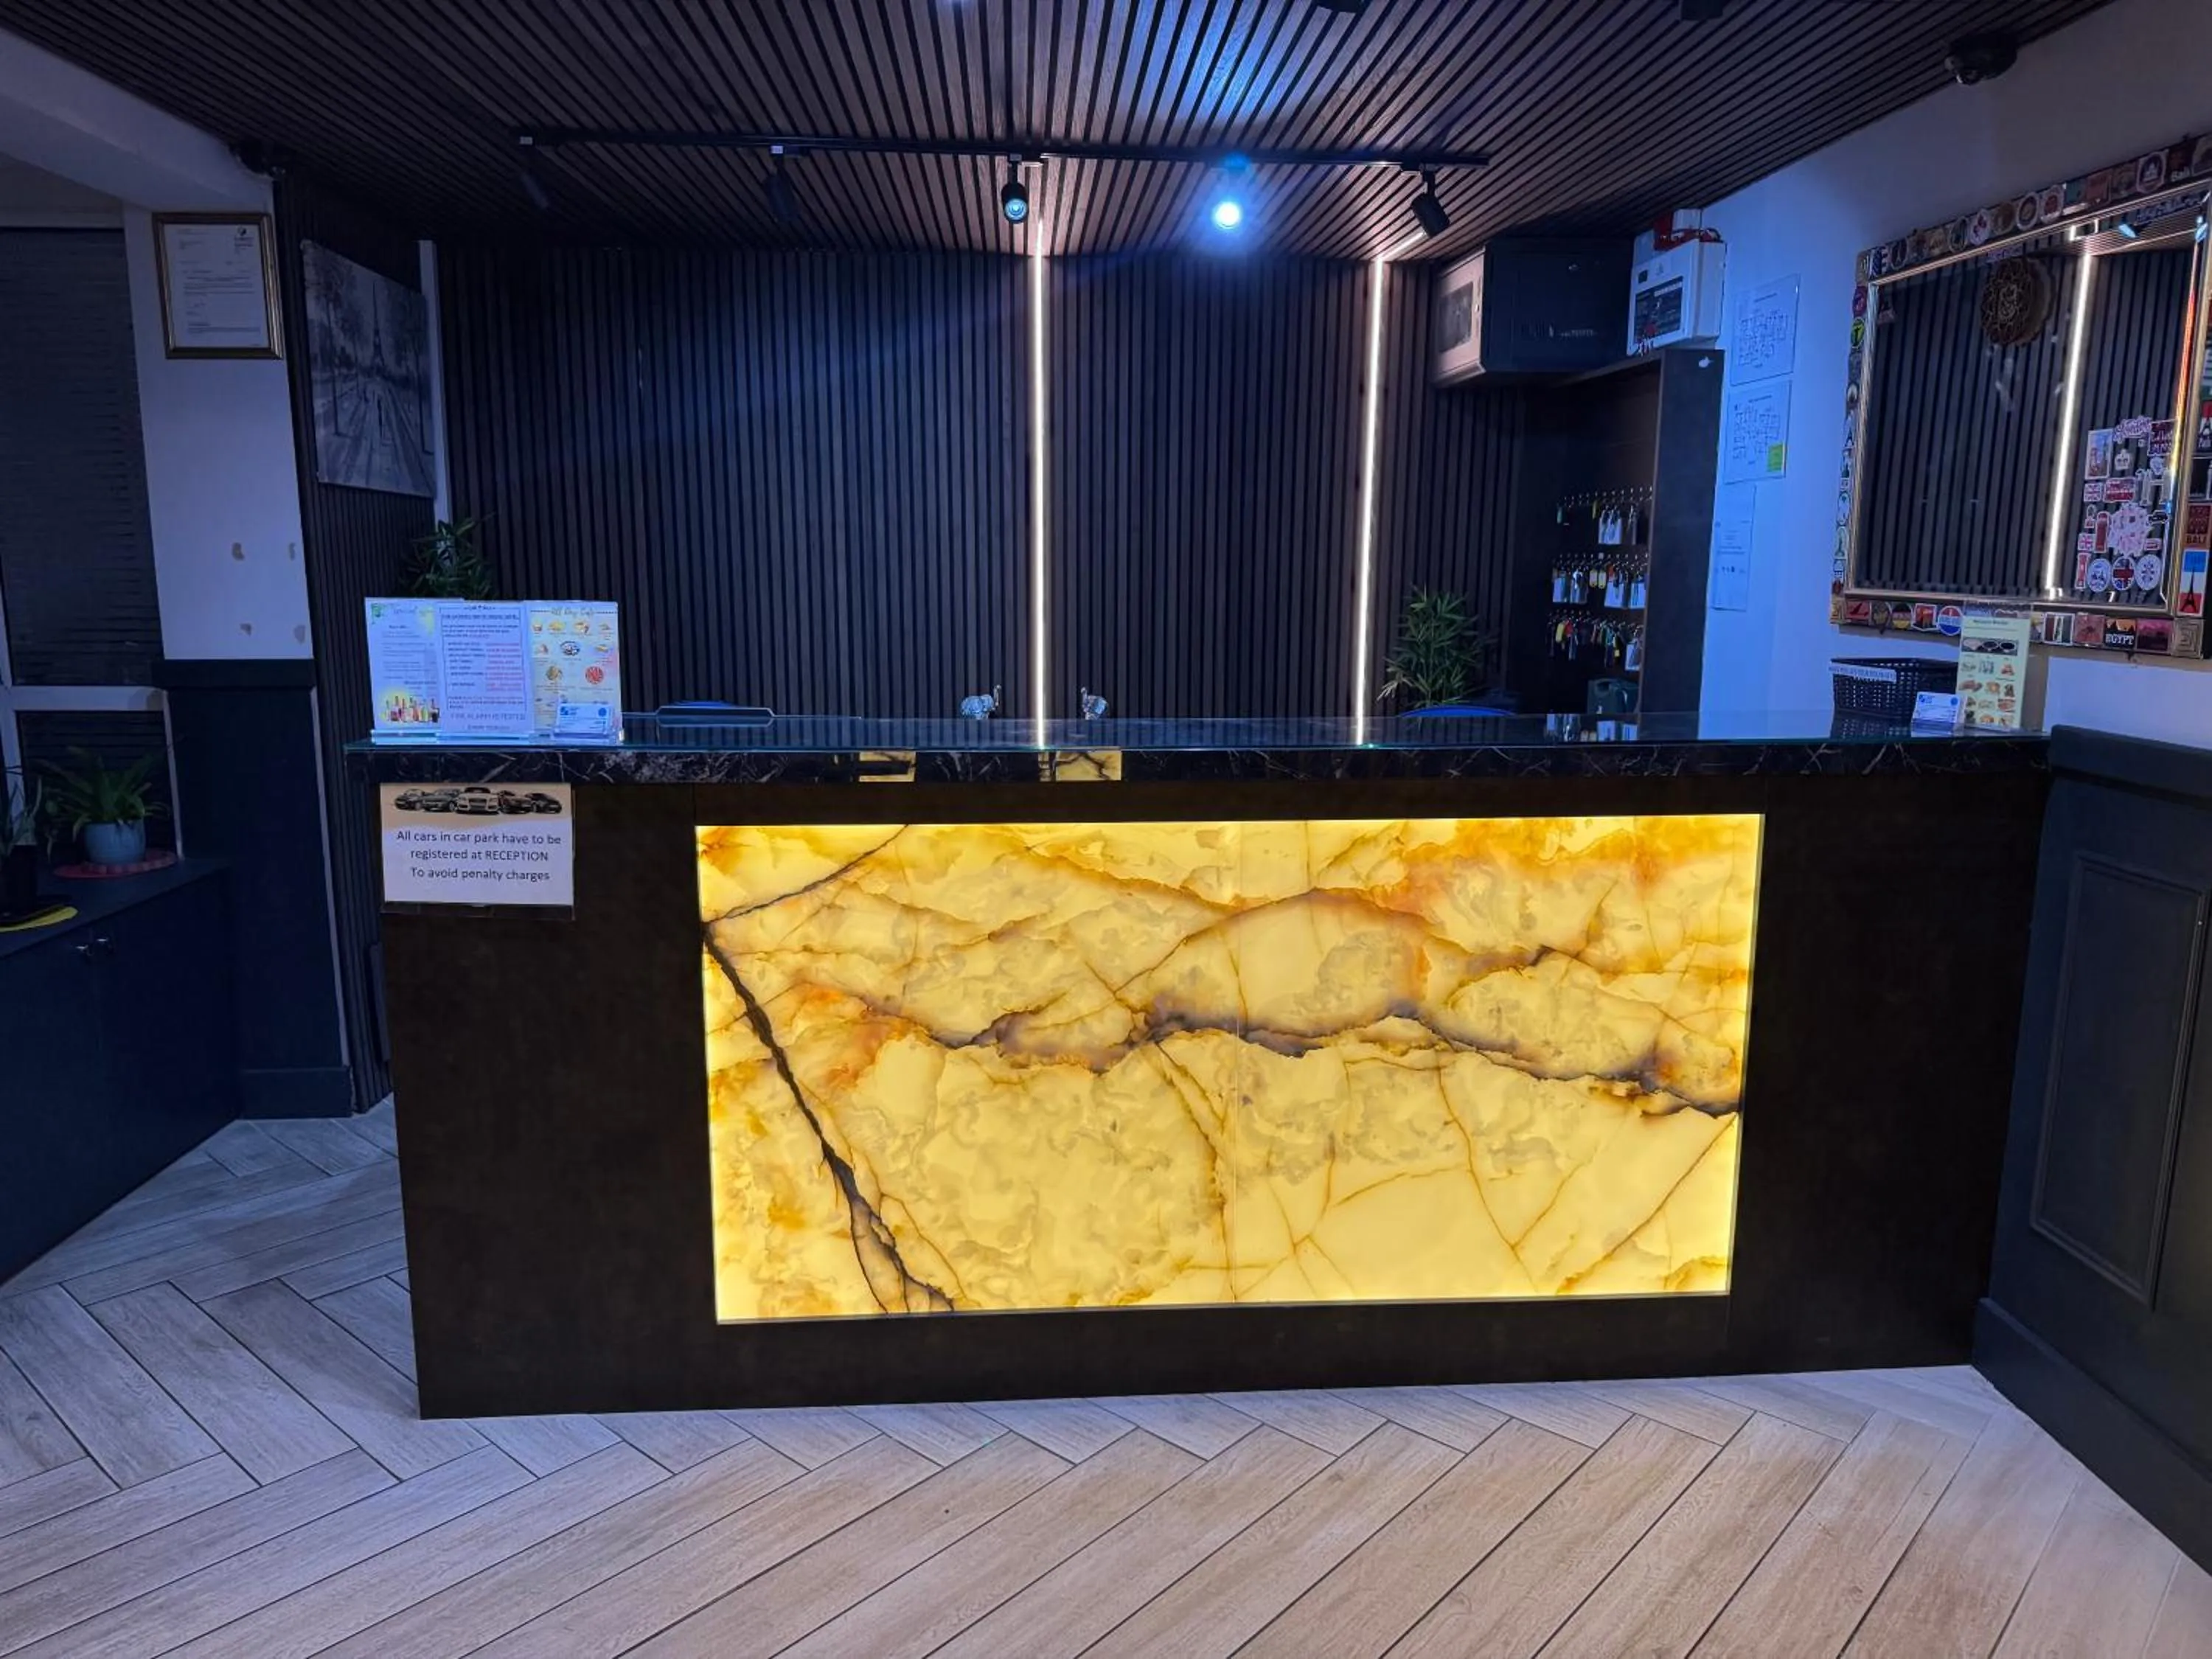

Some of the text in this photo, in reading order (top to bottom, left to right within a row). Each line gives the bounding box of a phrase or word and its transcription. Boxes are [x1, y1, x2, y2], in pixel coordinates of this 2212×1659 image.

[2105, 633, 2135, 645] EGYPT
[396, 830, 561, 845] All cars in car park have to be
[411, 848, 549, 862] registered at RECEPTION
[411, 867, 550, 883] To avoid penalty charges
